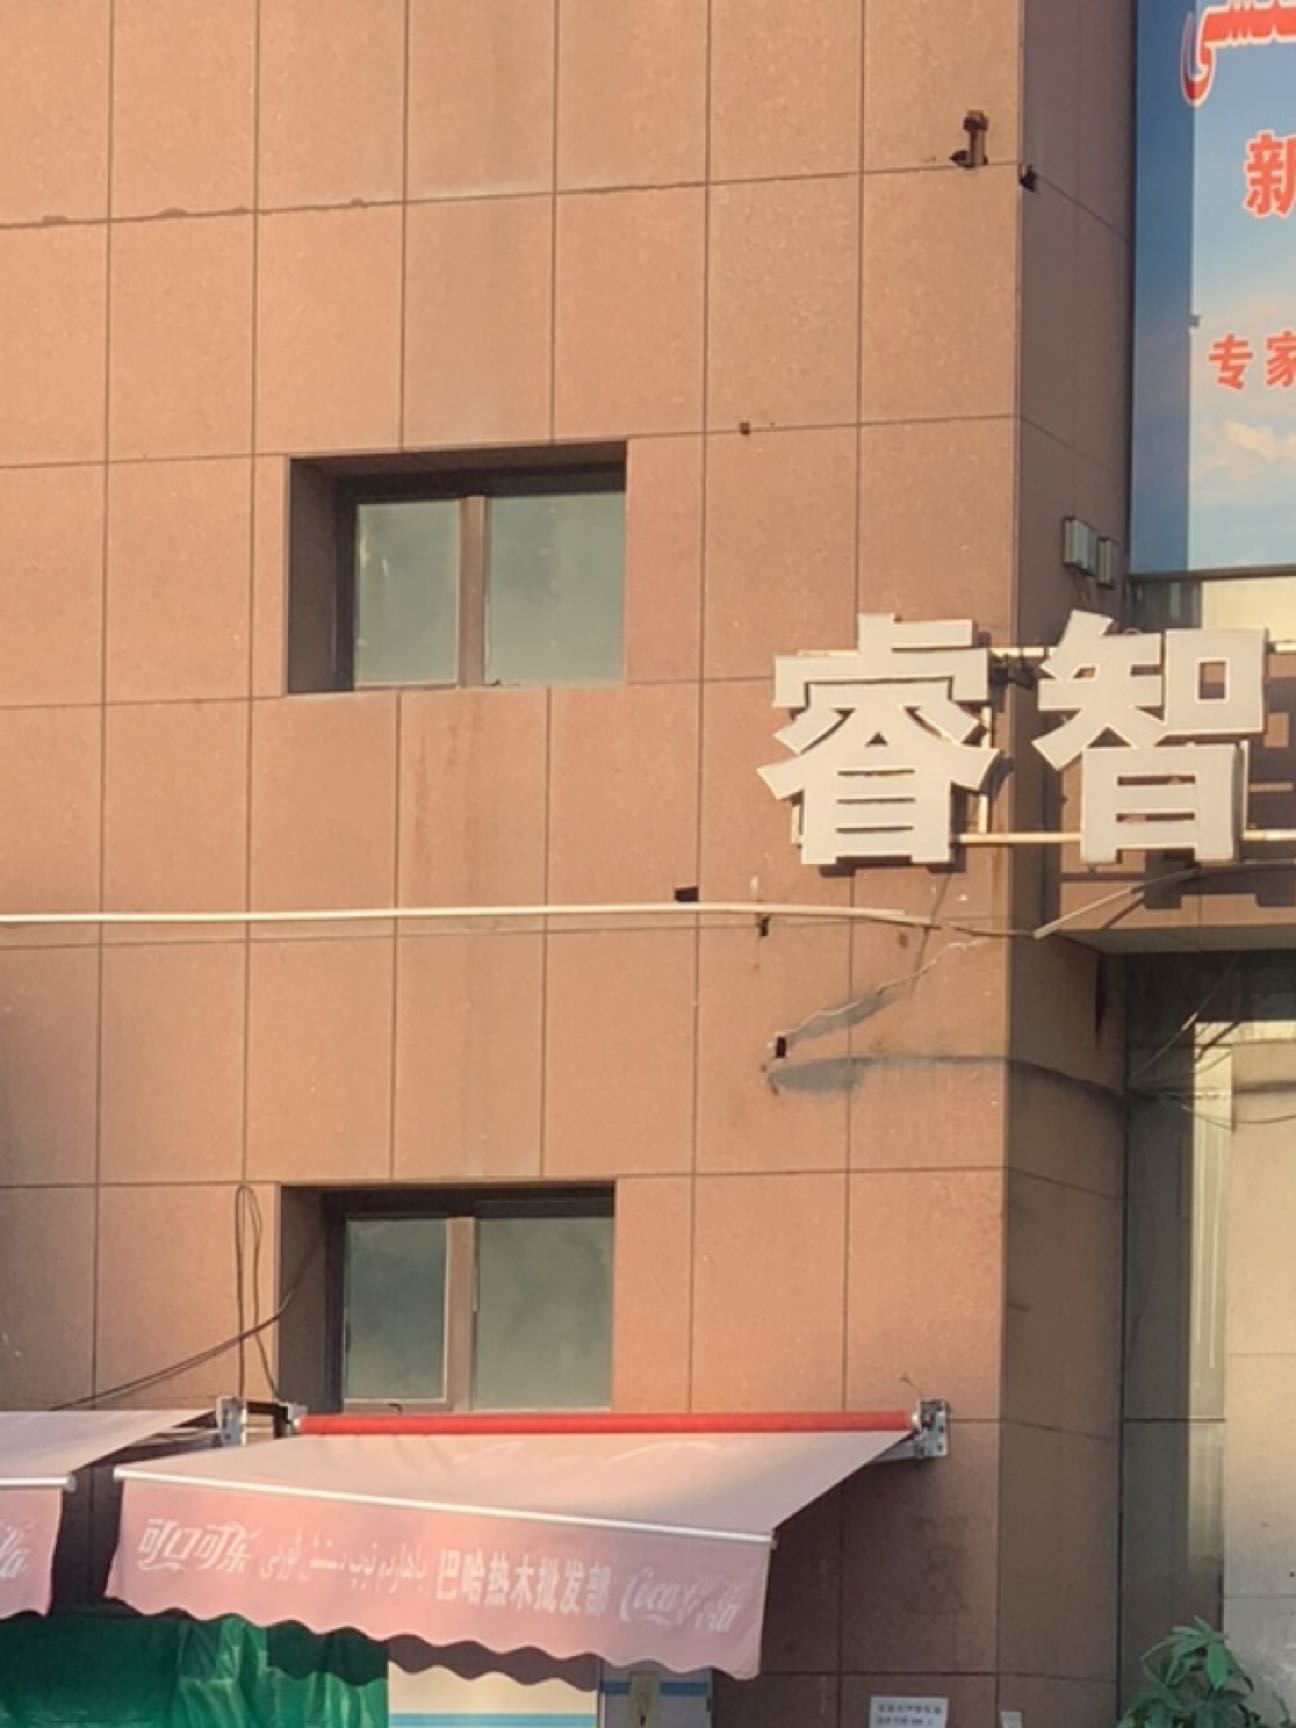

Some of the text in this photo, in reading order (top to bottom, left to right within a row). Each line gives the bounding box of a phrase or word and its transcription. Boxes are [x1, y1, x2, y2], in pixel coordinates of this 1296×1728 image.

[757, 610, 1268, 866] 睿智
[138, 1517, 262, 1575] 可口可乐
